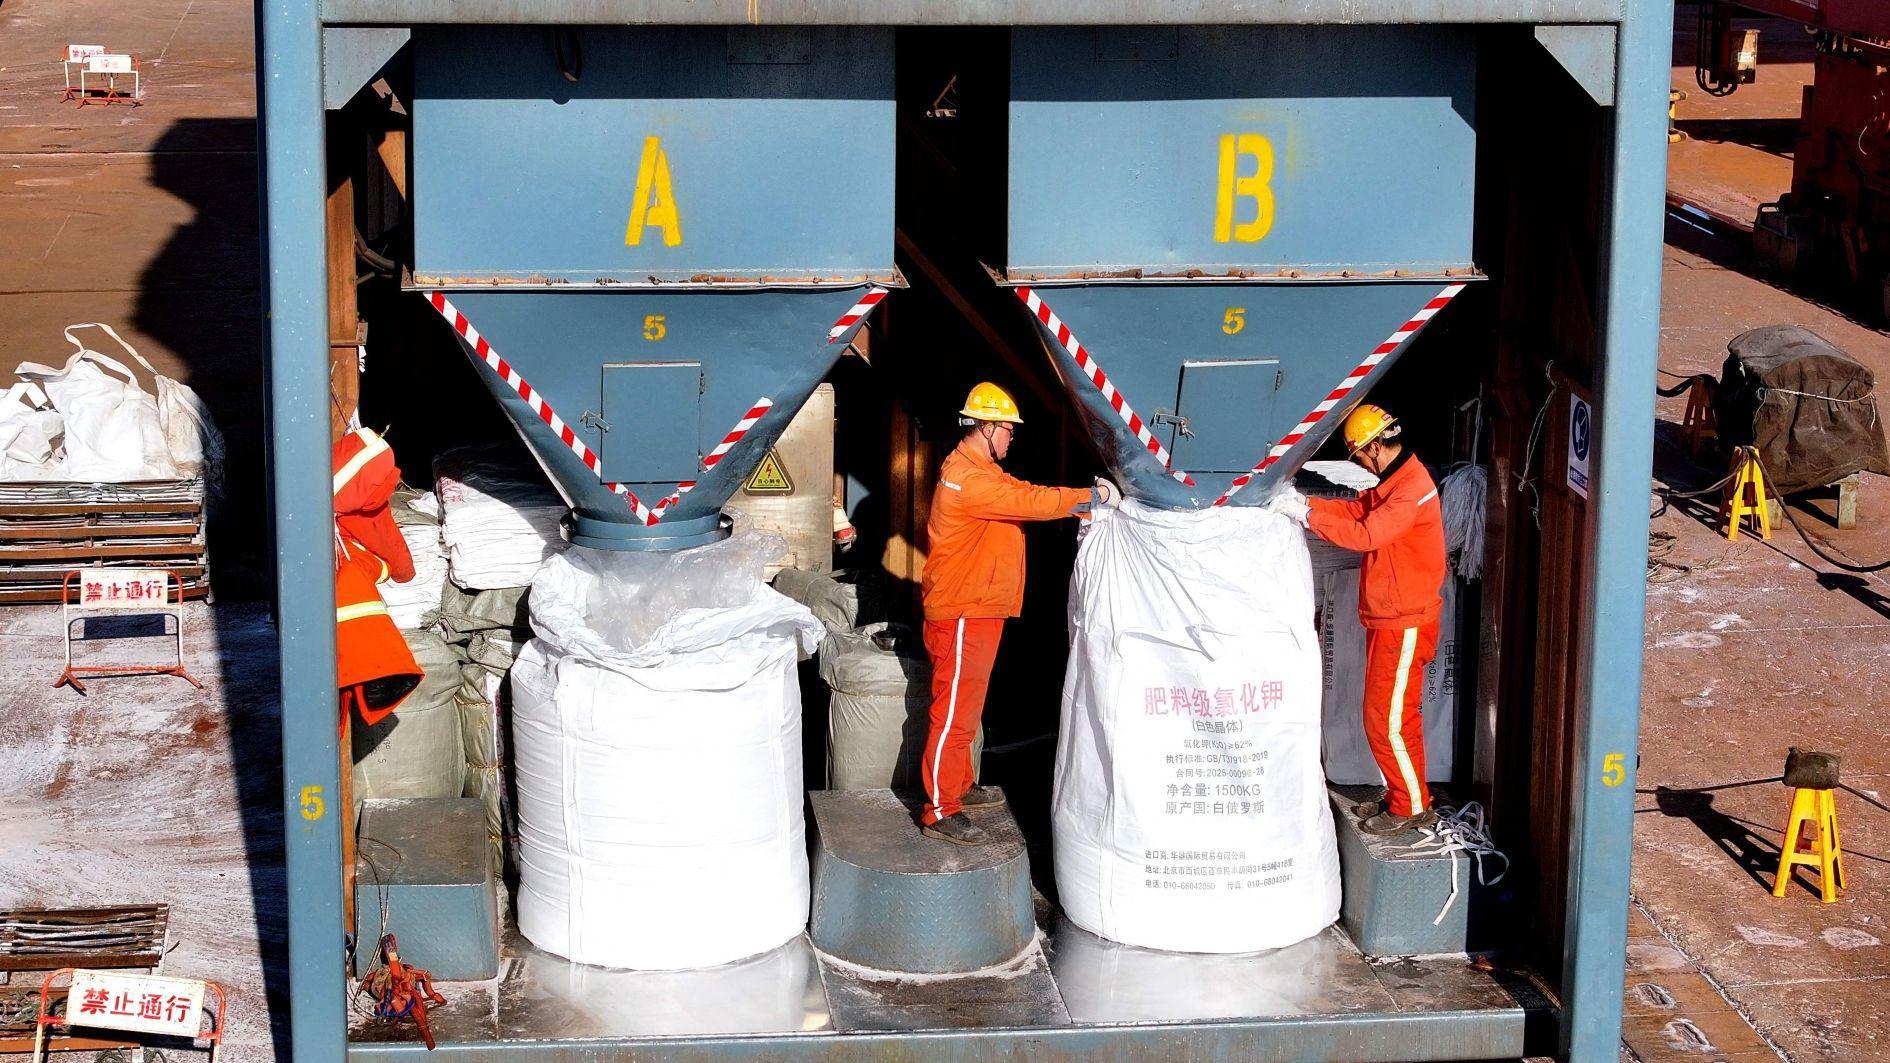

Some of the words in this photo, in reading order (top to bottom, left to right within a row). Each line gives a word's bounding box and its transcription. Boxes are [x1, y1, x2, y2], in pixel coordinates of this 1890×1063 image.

[625, 136, 682, 248] A
[1214, 133, 1276, 244] B
[643, 315, 667, 341] 5
[1222, 307, 1246, 335] 5
[85, 581, 163, 602] 禁止通行
[1144, 680, 1284, 717] 肥料级氯化钾
[1192, 719, 1243, 734] (白色晶体)
[1603, 753, 1625, 787] 5
[300, 785, 325, 820] 5
[1165, 801, 1265, 815] 原产国:白俄罗斯
